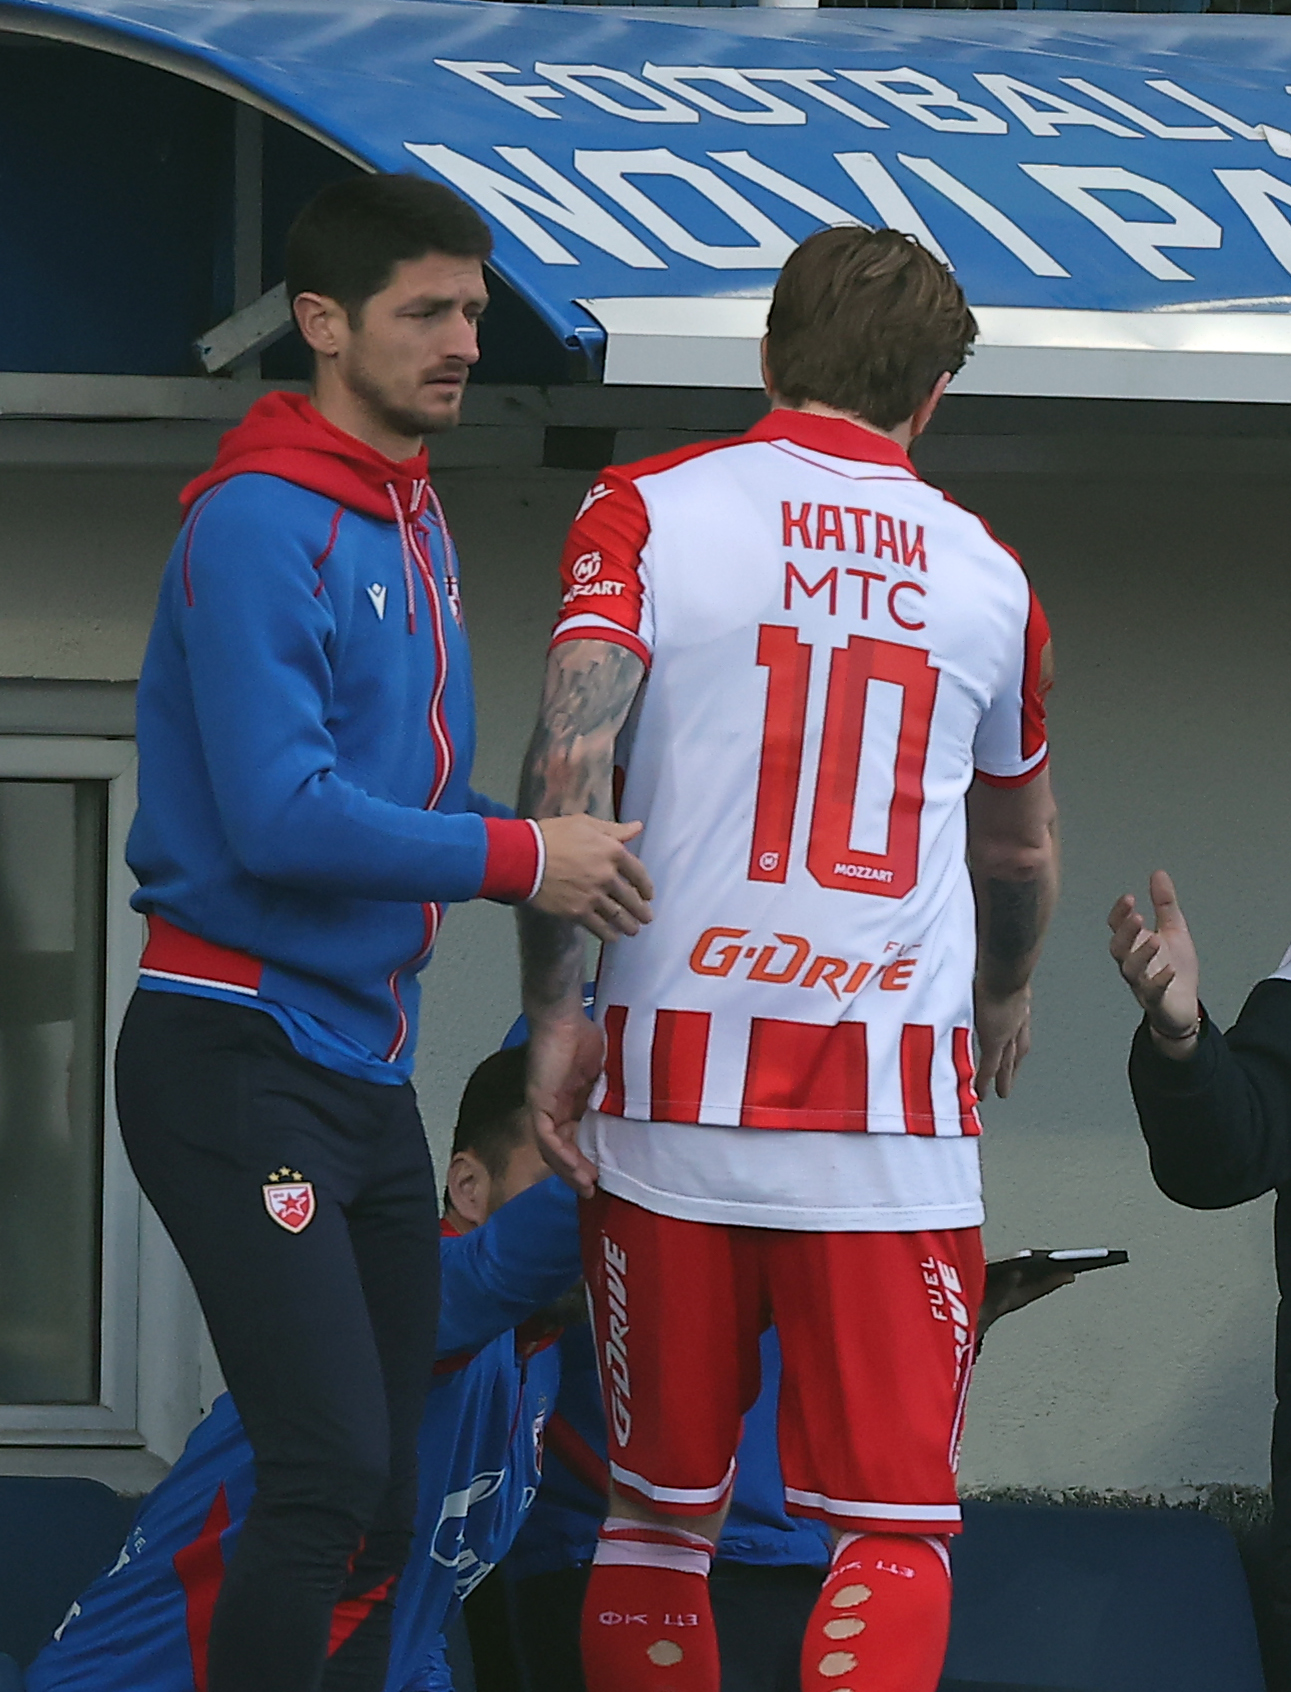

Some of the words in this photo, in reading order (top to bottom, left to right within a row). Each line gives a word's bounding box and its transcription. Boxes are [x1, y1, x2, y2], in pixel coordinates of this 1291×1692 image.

[403, 142, 1071, 279] NOVI
[747, 623, 939, 900] 10
[833, 863, 894, 884] MOZZART
[920, 1256, 948, 1321] FUEL
